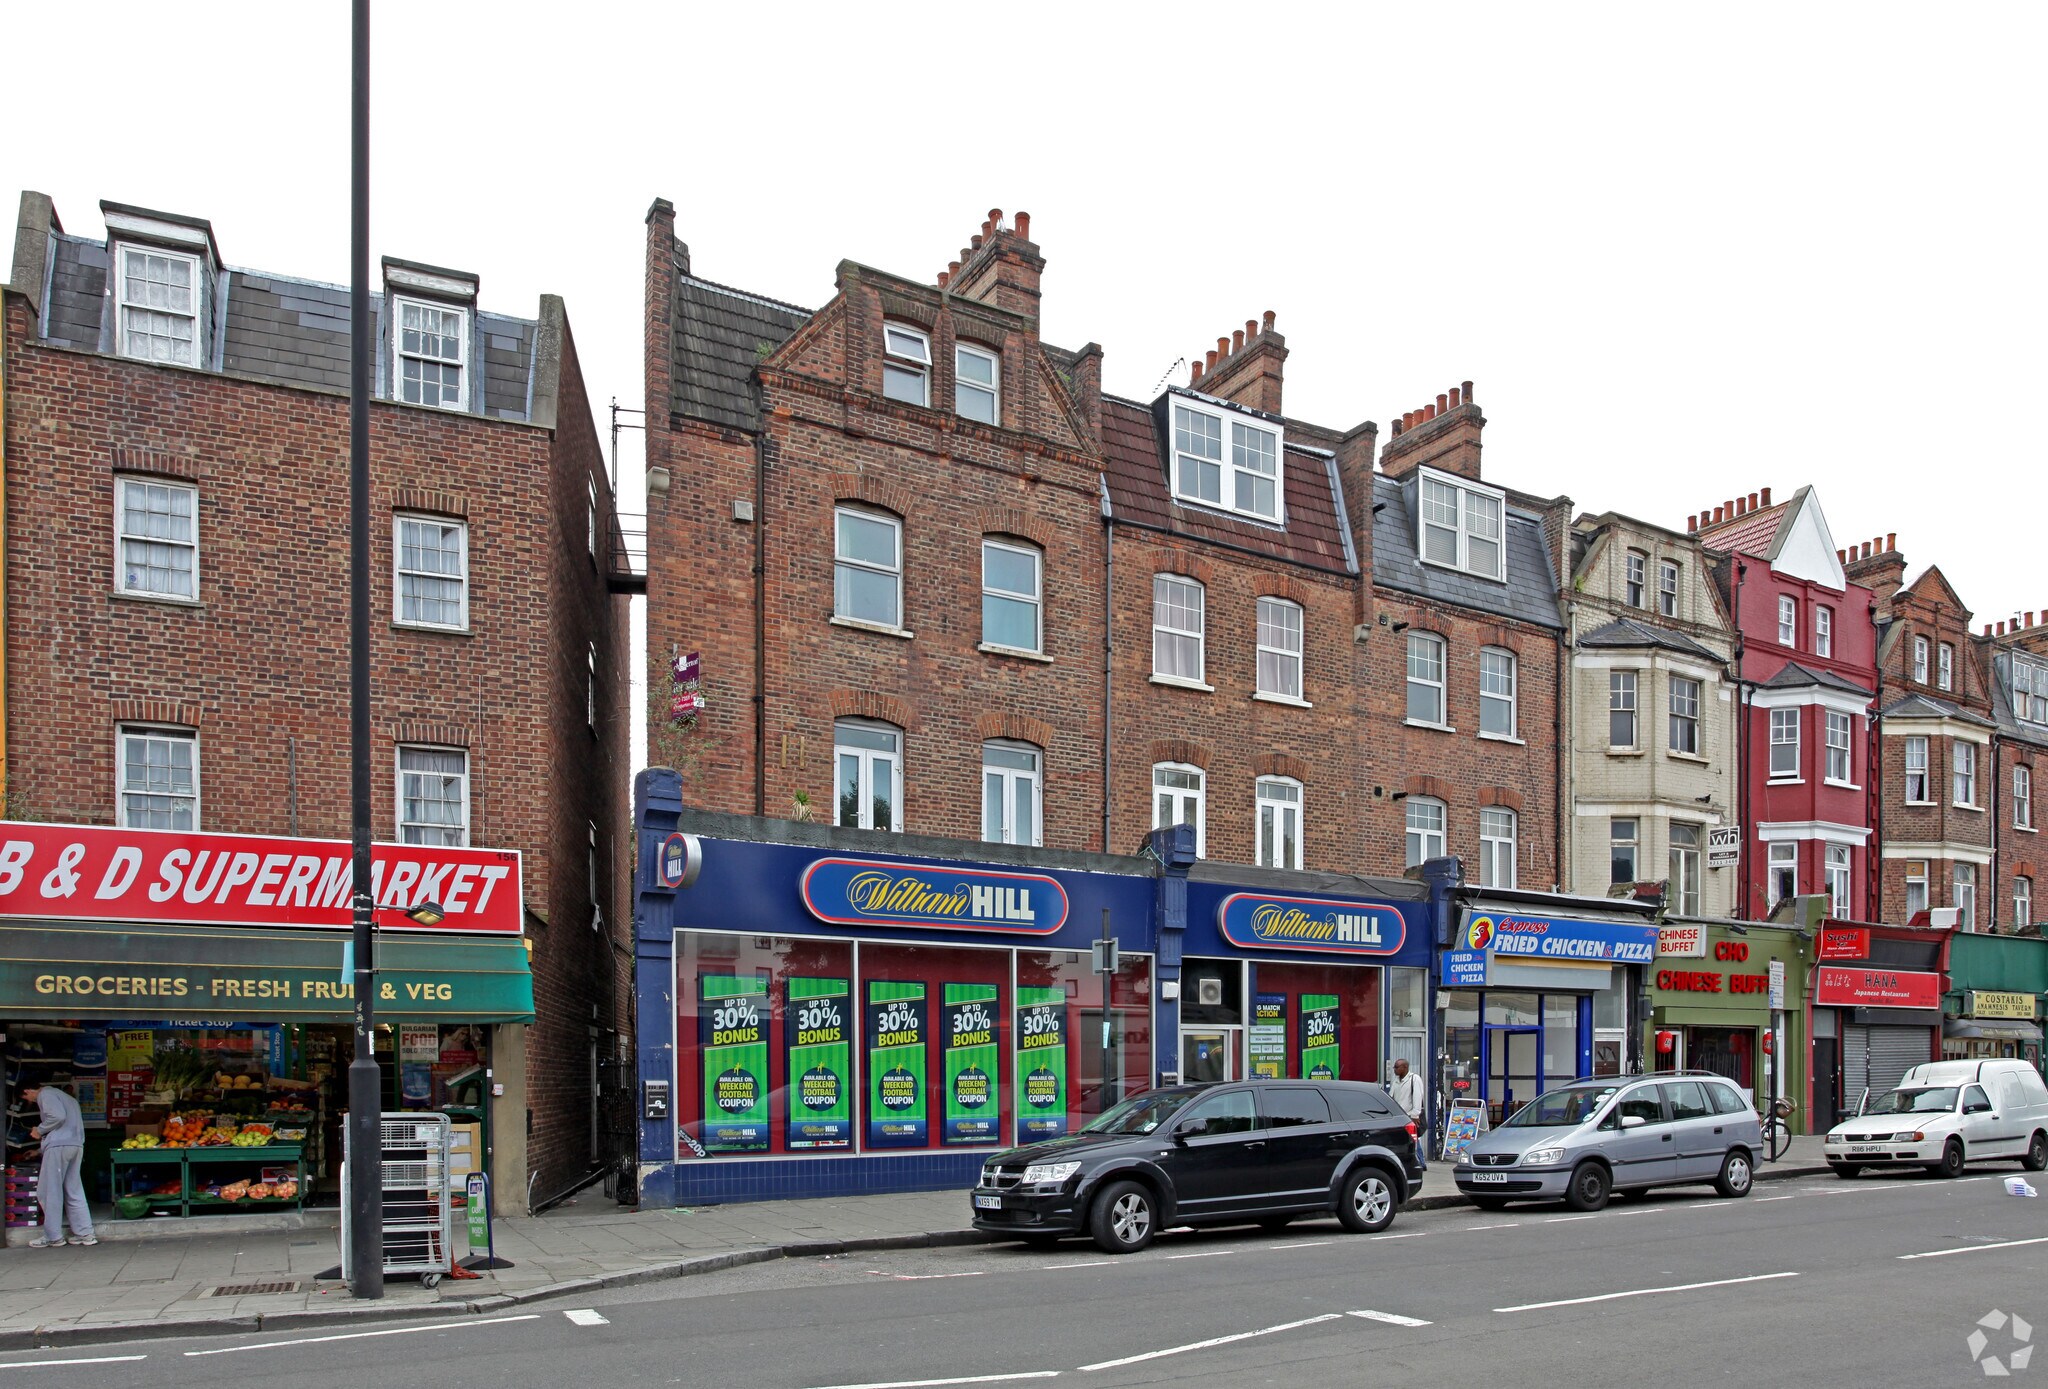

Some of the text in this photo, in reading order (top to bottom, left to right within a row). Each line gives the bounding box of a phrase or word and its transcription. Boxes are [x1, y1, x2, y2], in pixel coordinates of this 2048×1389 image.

[1711, 828, 1737, 845] wh
[496, 852, 518, 862] 156
[668, 858, 682, 878] HILL
[0, 841, 510, 914] B & D SUPERMARKET
[847, 871, 1034, 920] William HILL
[1252, 904, 1381, 943] William HILL
[1498, 917, 1550, 934] Express
[1659, 929, 1698, 940] CHINESE
[1827, 932, 1858, 941] Sushi
[1494, 935, 1653, 960] FRIED CHICKEN & PIZZA
[1661, 942, 1694, 952] BUFFET
[1715, 941, 1749, 962] CHO
[1451, 954, 1472, 962] FRIED
[1451, 963, 1484, 972] CHICKEN
[1451, 973, 1484, 982] & PIZZA
[1657, 970, 1786, 993] CHINESE BUFF
[1864, 973, 1897, 988] HANA
[35, 975, 188, 996] GROCERIES
[212, 979, 290, 998] FRESH
[302, 981, 354, 999] FRUI
[380, 983, 396, 999] &
[406, 983, 452, 1000] VEG
[1854, 989, 1910, 998] Japanese Restaurant
[724, 998, 747, 1008] UP TO
[809, 999, 830, 1008] UP TO
[899, 1002, 907, 1010] TO
[1985, 994, 2023, 1004] COSTAKIS
[962, 1005, 971, 1013] UP
[713, 1005, 759, 1029] 30%
[798, 1006, 840, 1030] 30%
[878, 1008, 918, 1032] 30%
[953, 1009, 990, 1033] 30%
[1024, 1012, 1059, 1034] 30%
[1308, 1017, 1334, 1036] 30%
[125, 1032, 150, 1041] FREE
[402, 1034, 437, 1046] FOOD
[713, 1028, 759, 1045] BONUS
[798, 1028, 841, 1045] BONUS
[878, 1030, 918, 1046] BONUS
[953, 1030, 990, 1046] BONUS
[1024, 1032, 1059, 1048] BONUS
[1308, 1033, 1334, 1047] BONUS
[719, 1082, 753, 1090] WEEKEND
[883, 1081, 913, 1089] WEEKEND
[1453, 1081, 1470, 1089] OPEN
[719, 1099, 754, 1107] COUPON
[804, 1097, 836, 1105] COUPON
[883, 1097, 914, 1105] COUPON
[958, 1095, 986, 1103] COUPON
[742, 1128, 756, 1136] HILL
[688, 1139, 706, 1158] 20p
